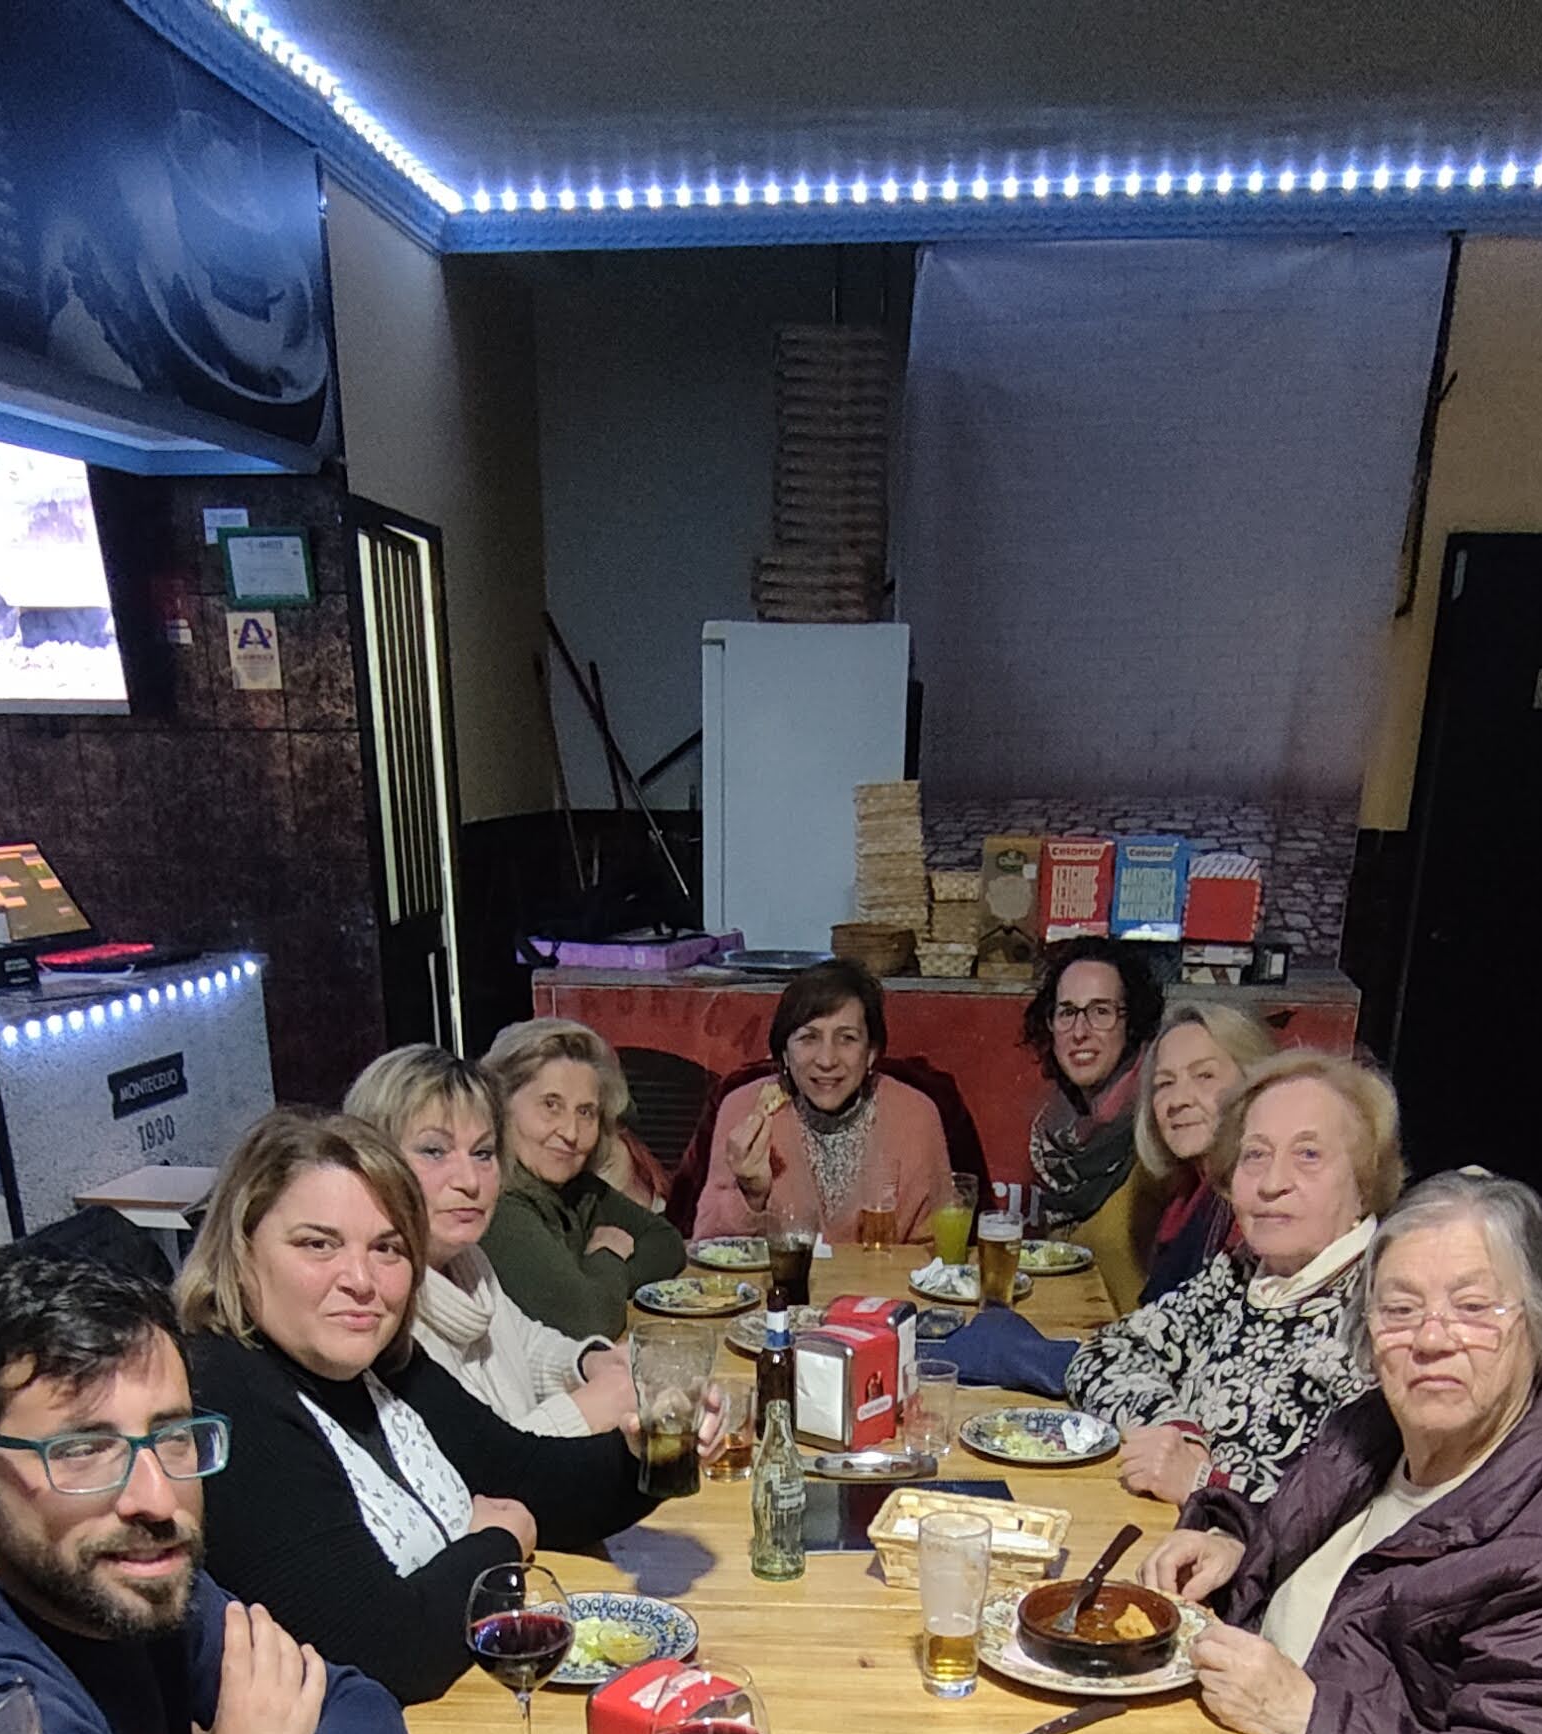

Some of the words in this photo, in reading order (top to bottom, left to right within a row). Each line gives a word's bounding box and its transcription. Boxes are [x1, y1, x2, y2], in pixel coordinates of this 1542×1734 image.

[238, 618, 271, 650] A
[1051, 846, 1101, 857] Celorrio
[1128, 847, 1173, 858] Celorrio
[119, 1068, 179, 1102] MONTECELIO
[137, 1114, 176, 1151] 1930
